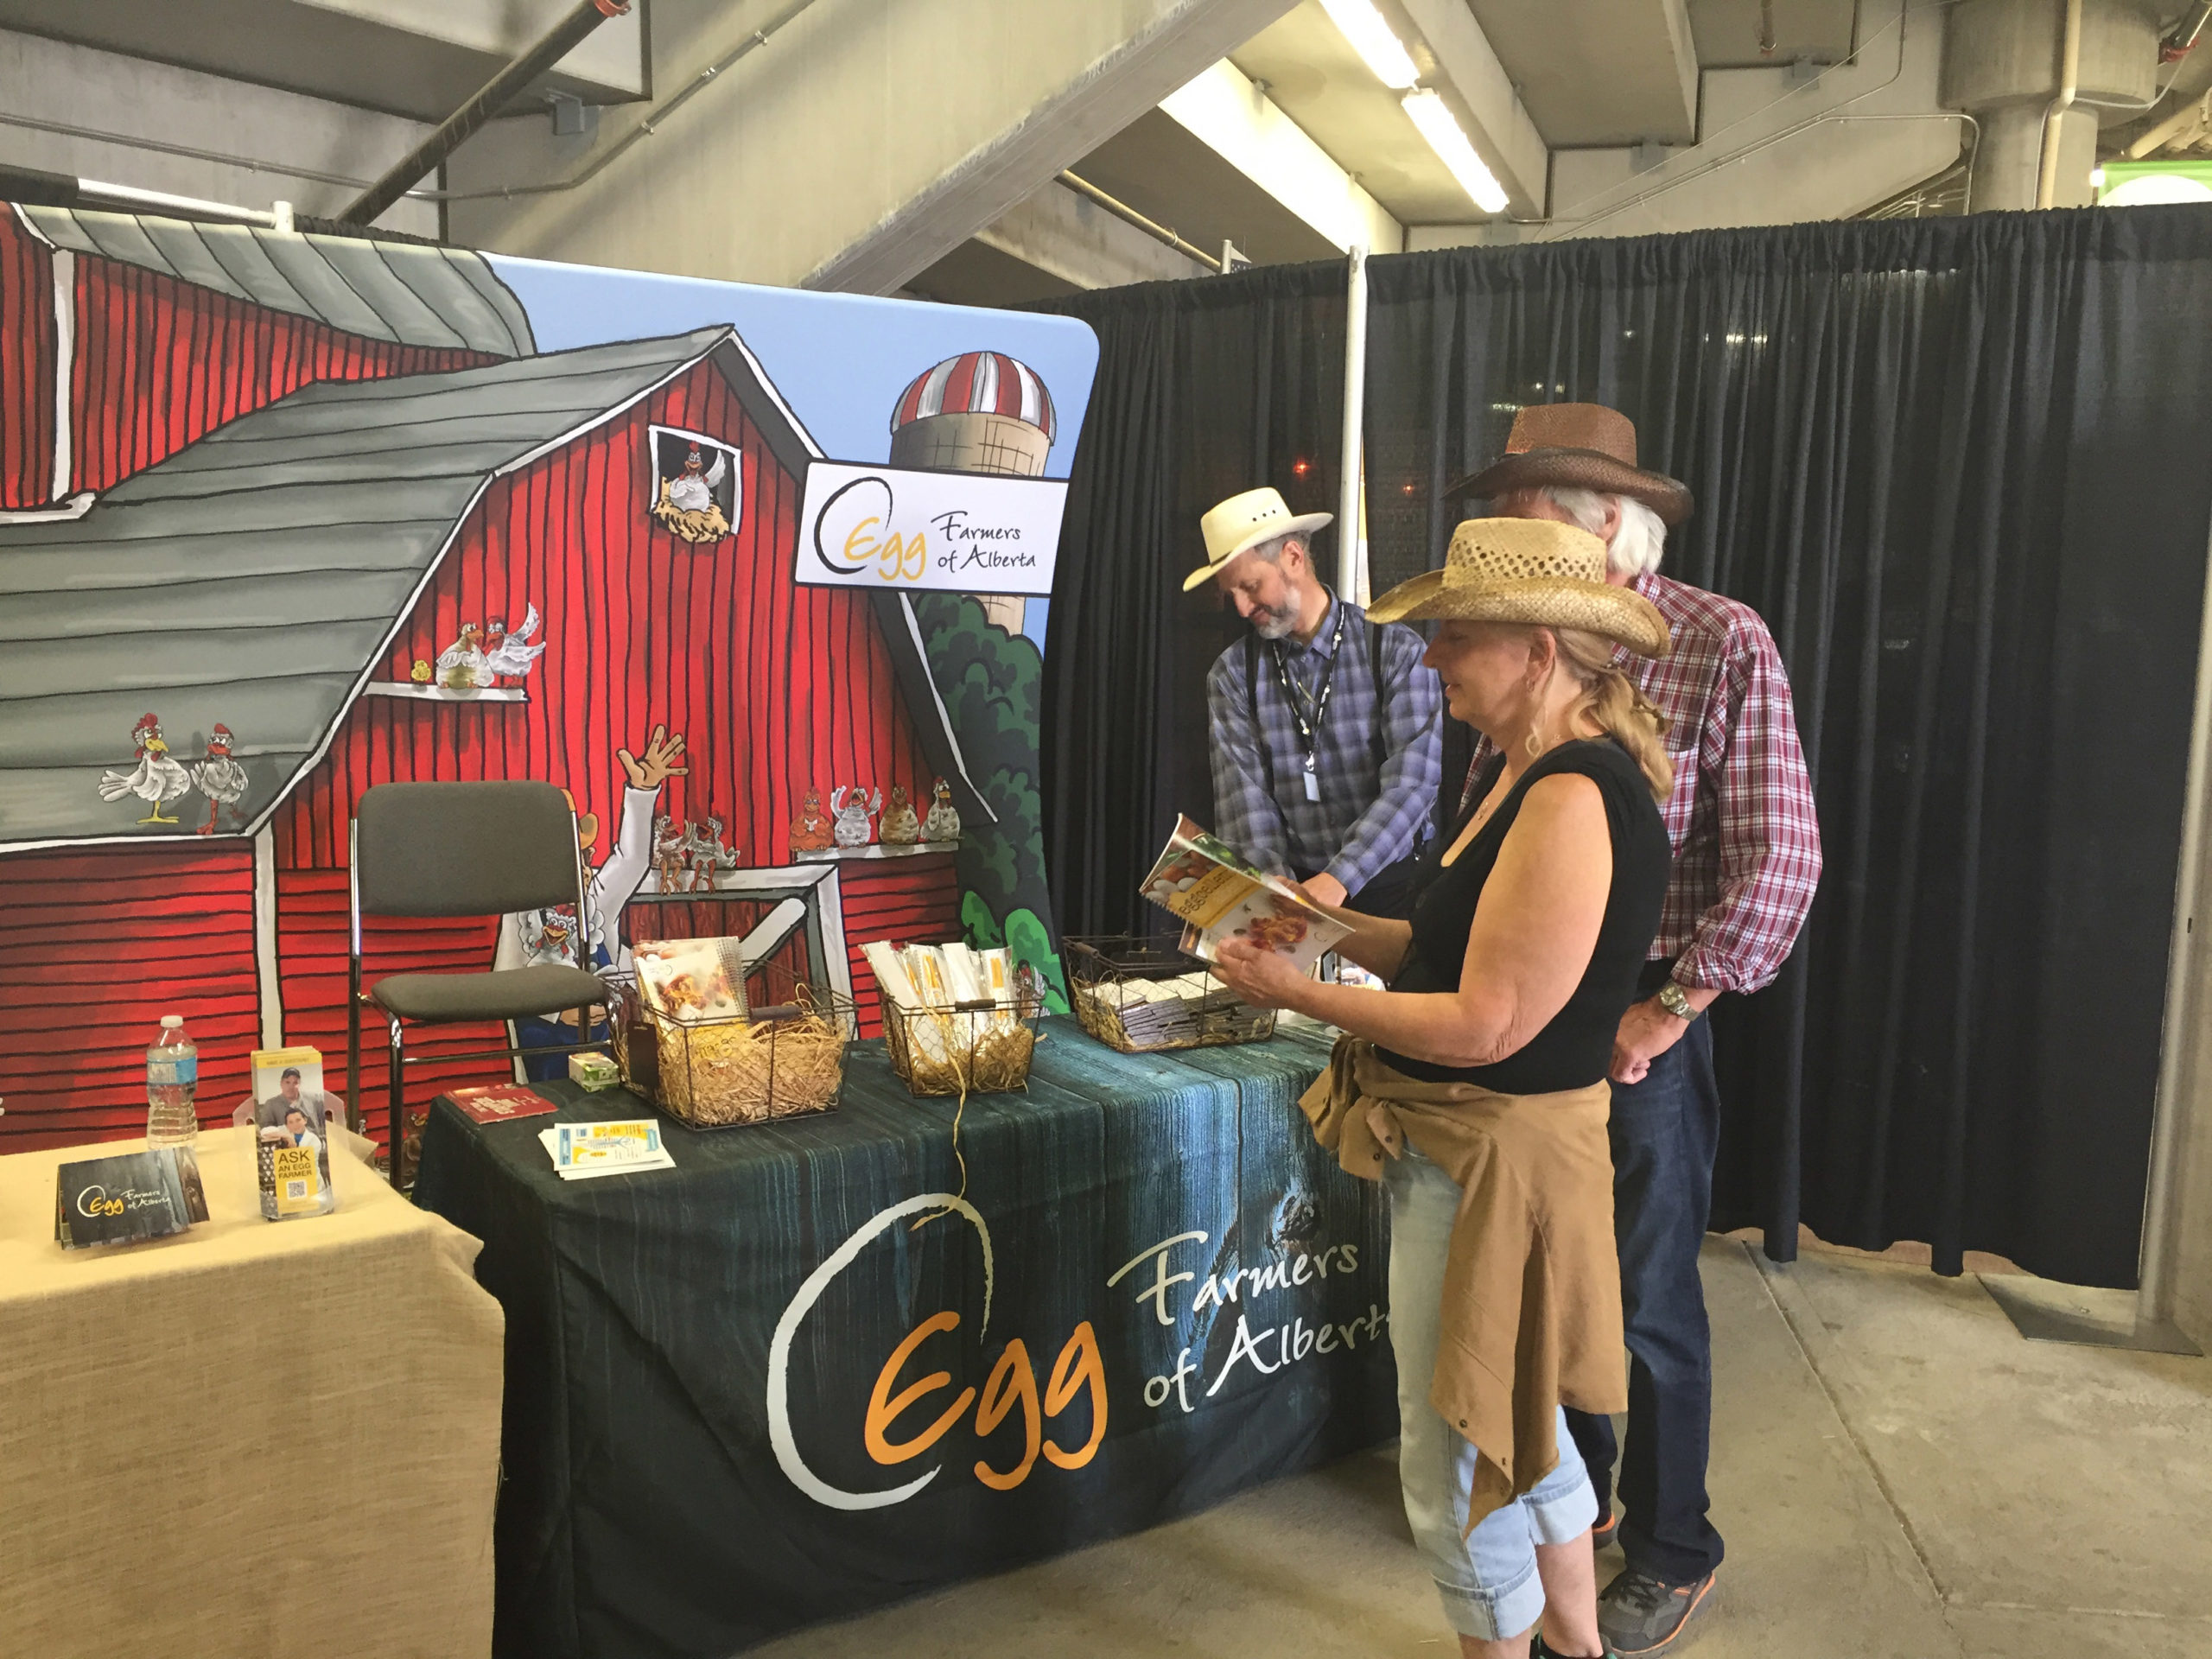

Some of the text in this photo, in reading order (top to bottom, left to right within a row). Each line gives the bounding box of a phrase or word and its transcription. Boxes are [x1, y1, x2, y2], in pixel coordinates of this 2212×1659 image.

[931, 511, 1021, 542] Farmers
[843, 516, 927, 581] Egg
[938, 544, 1037, 574] of Alberta
[278, 1150, 310, 1165] ASK
[278, 1162, 311, 1173] AN EGG
[278, 1169, 312, 1179] FARMER
[120, 1188, 161, 1200] Farmers
[127, 1196, 171, 1211] of Alberta
[90, 1197, 124, 1217] Egg
[1107, 1230, 1359, 1325] Farmers
[1143, 1304, 1390, 1413] of Albert
[863, 1311, 1109, 1491] Egg
